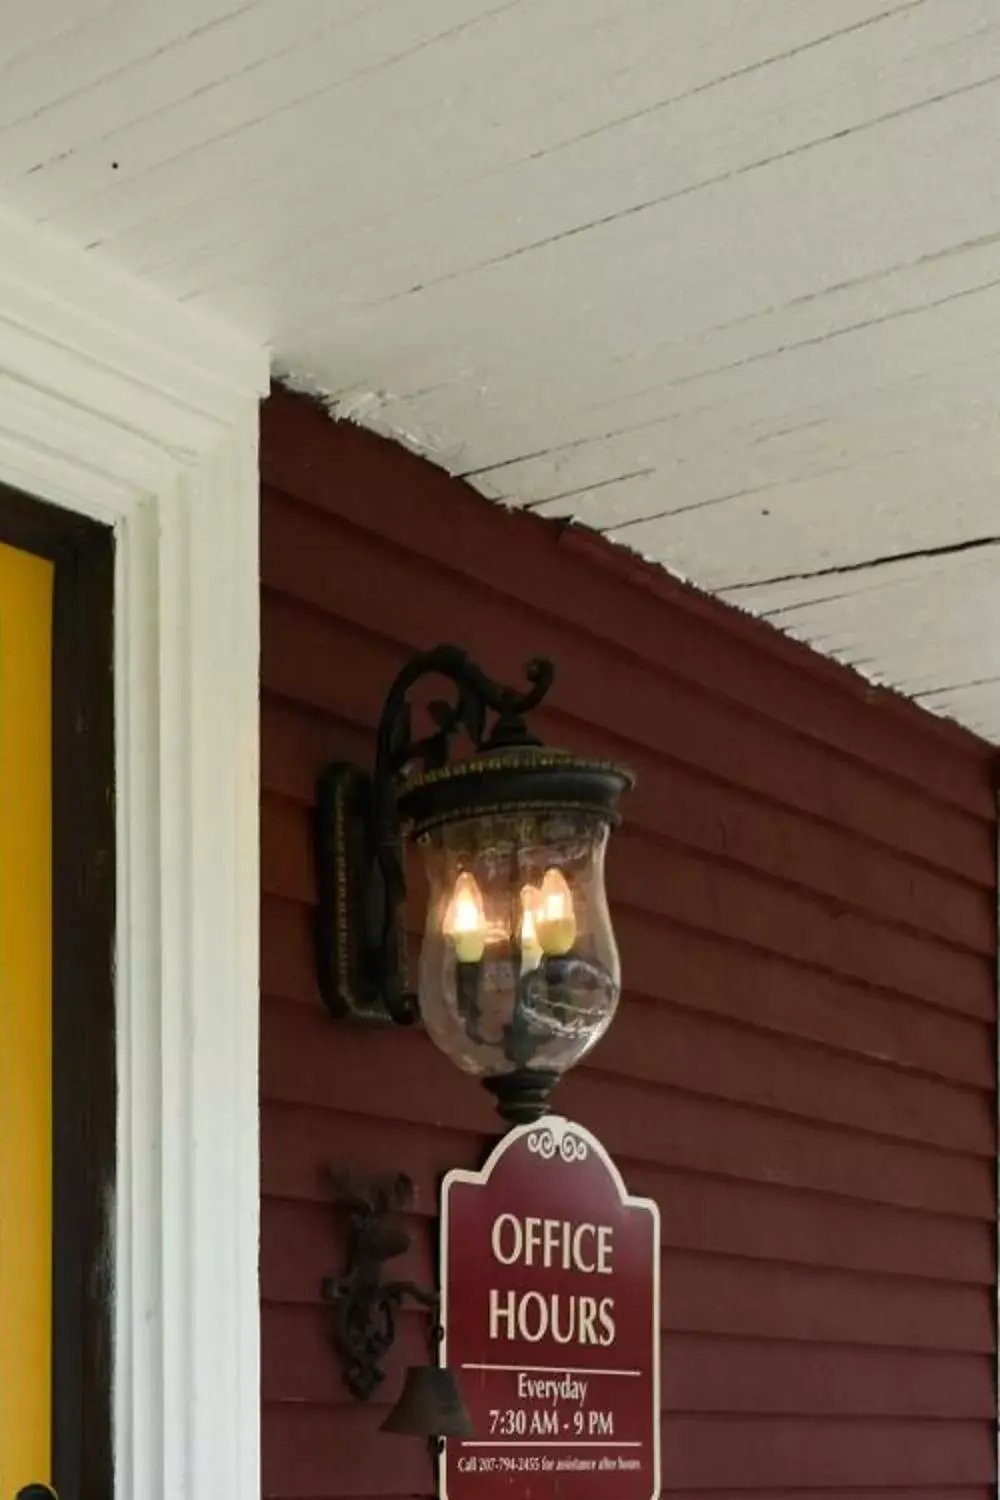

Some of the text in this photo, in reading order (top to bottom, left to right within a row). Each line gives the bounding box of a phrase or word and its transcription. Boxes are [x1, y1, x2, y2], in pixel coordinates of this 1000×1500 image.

[491, 1213, 613, 1274] OFFICE
[489, 1289, 616, 1347] HOURS
[517, 1372, 588, 1408] Everyday
[488, 1410, 527, 1435] 7:30
[529, 1410, 559, 1436] AM
[573, 1411, 584, 1436] 9
[589, 1411, 614, 1436] PM
[456, 1456, 478, 1473] Call
